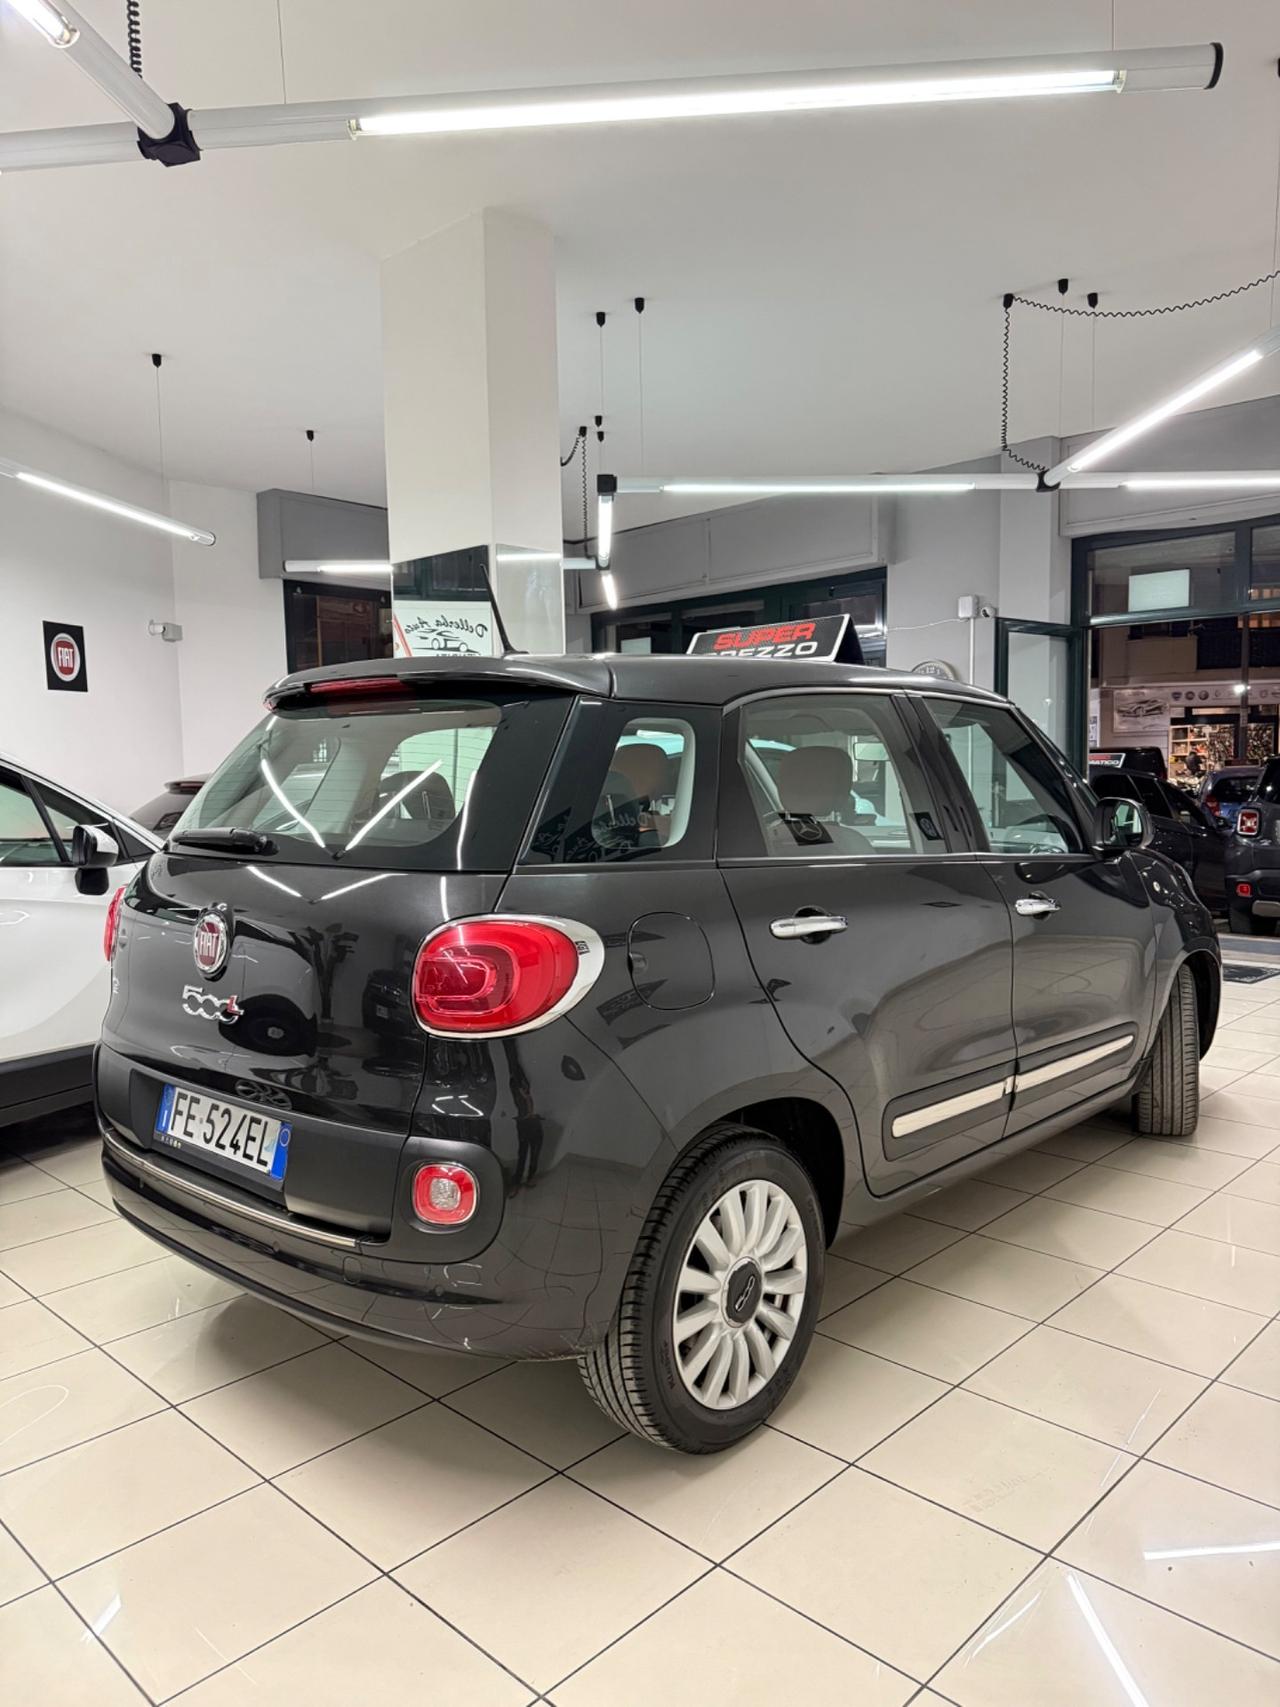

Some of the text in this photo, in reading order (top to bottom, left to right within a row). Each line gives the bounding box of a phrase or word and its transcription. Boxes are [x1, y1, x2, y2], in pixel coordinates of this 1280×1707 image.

[703, 641, 818, 658] EZZO
[713, 622, 817, 651] SUPER
[57, 646, 74, 668] FIAT
[199, 930, 220, 958] FIAT
[182, 985, 245, 1025] 500L
